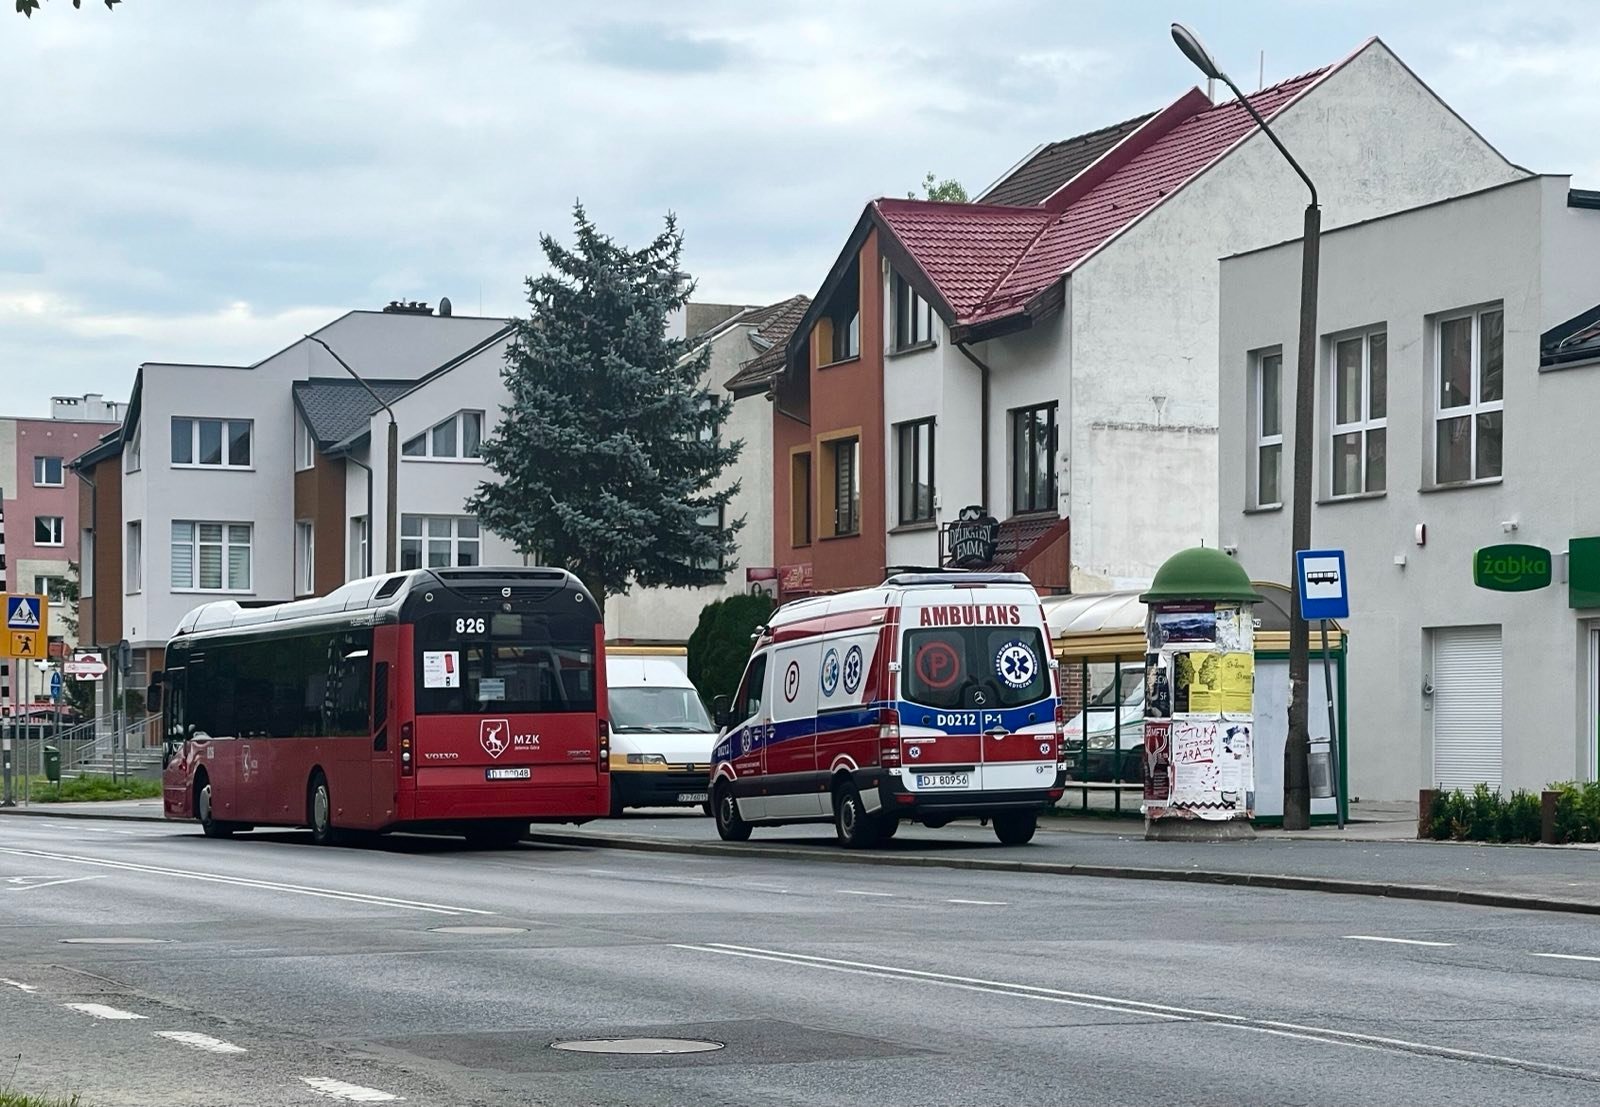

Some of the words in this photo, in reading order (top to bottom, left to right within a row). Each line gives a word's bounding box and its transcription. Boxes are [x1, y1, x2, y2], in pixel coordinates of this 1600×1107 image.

[950, 524, 991, 549] DELIKATESY
[957, 540, 984, 560] EMMA
[1484, 555, 1547, 574] żabka
[920, 605, 1020, 626] AMBULANS
[456, 618, 485, 633] 826
[930, 653, 948, 678] P
[788, 670, 796, 694] P
[937, 714, 976, 726] D0212
[985, 714, 1002, 724] P-1
[514, 735, 540, 744] MZK
[1174, 725, 1217, 741] SZTUKA
[923, 775, 936, 785] DJ
[939, 775, 967, 784] 80956
